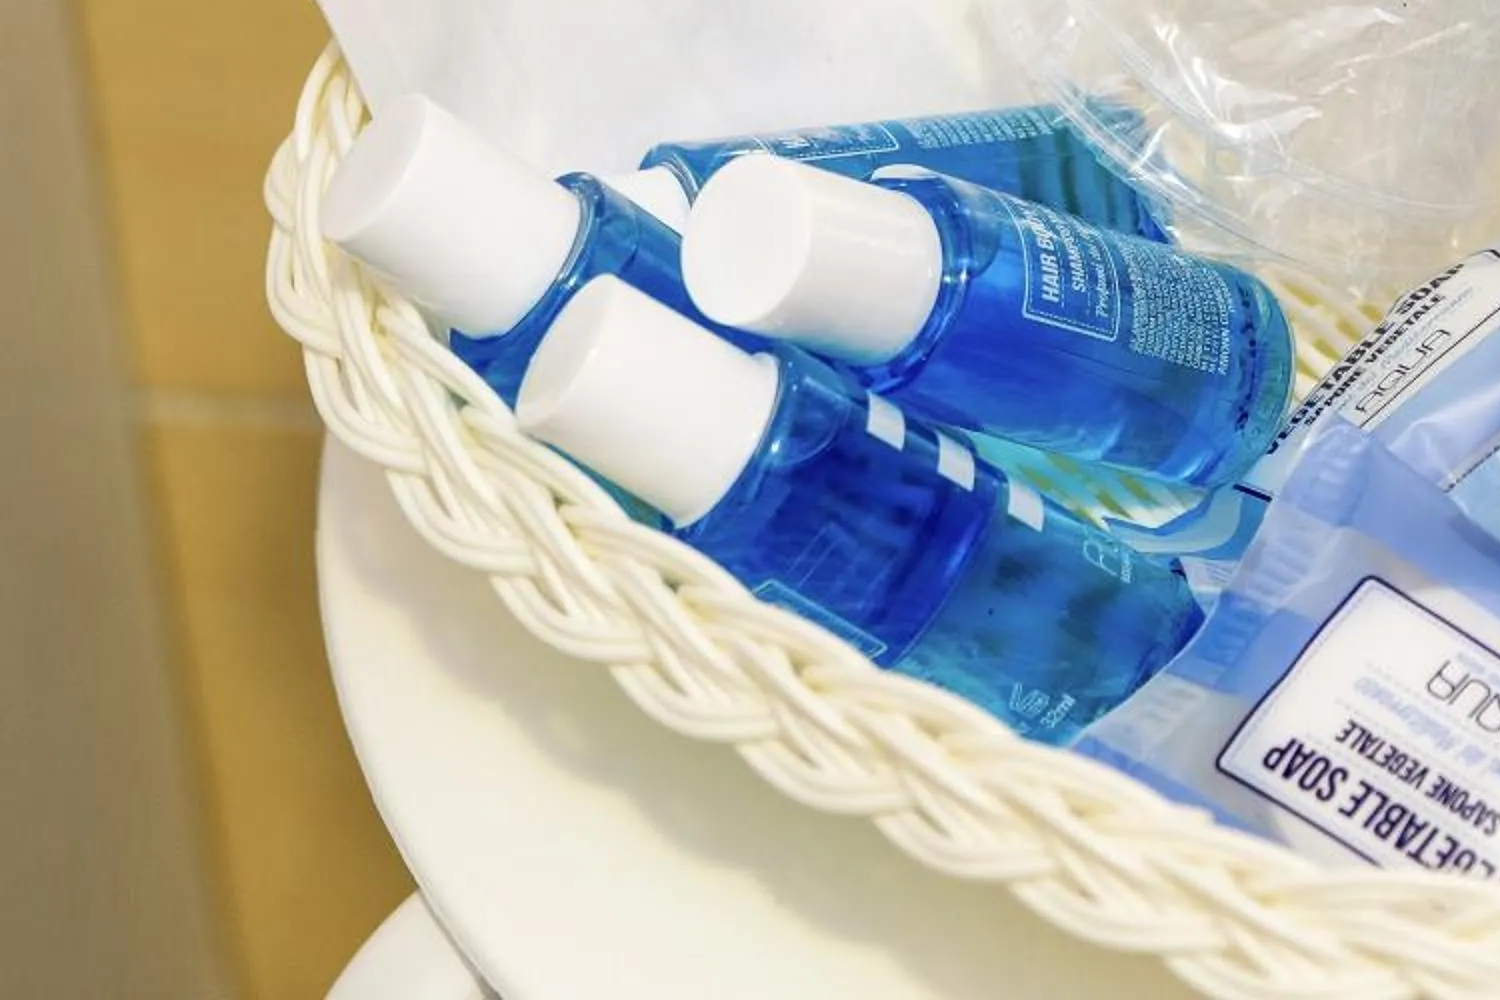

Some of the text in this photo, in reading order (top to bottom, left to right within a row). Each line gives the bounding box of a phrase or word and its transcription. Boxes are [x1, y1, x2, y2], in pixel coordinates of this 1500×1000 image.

[1040, 254, 1058, 301] HAIR
[1304, 292, 1445, 426] SAPONE VEGETALE
[1354, 328, 1451, 414] AQUA
[1260, 733, 1349, 804] SOAP
[1333, 719, 1426, 789] VEGETALE
